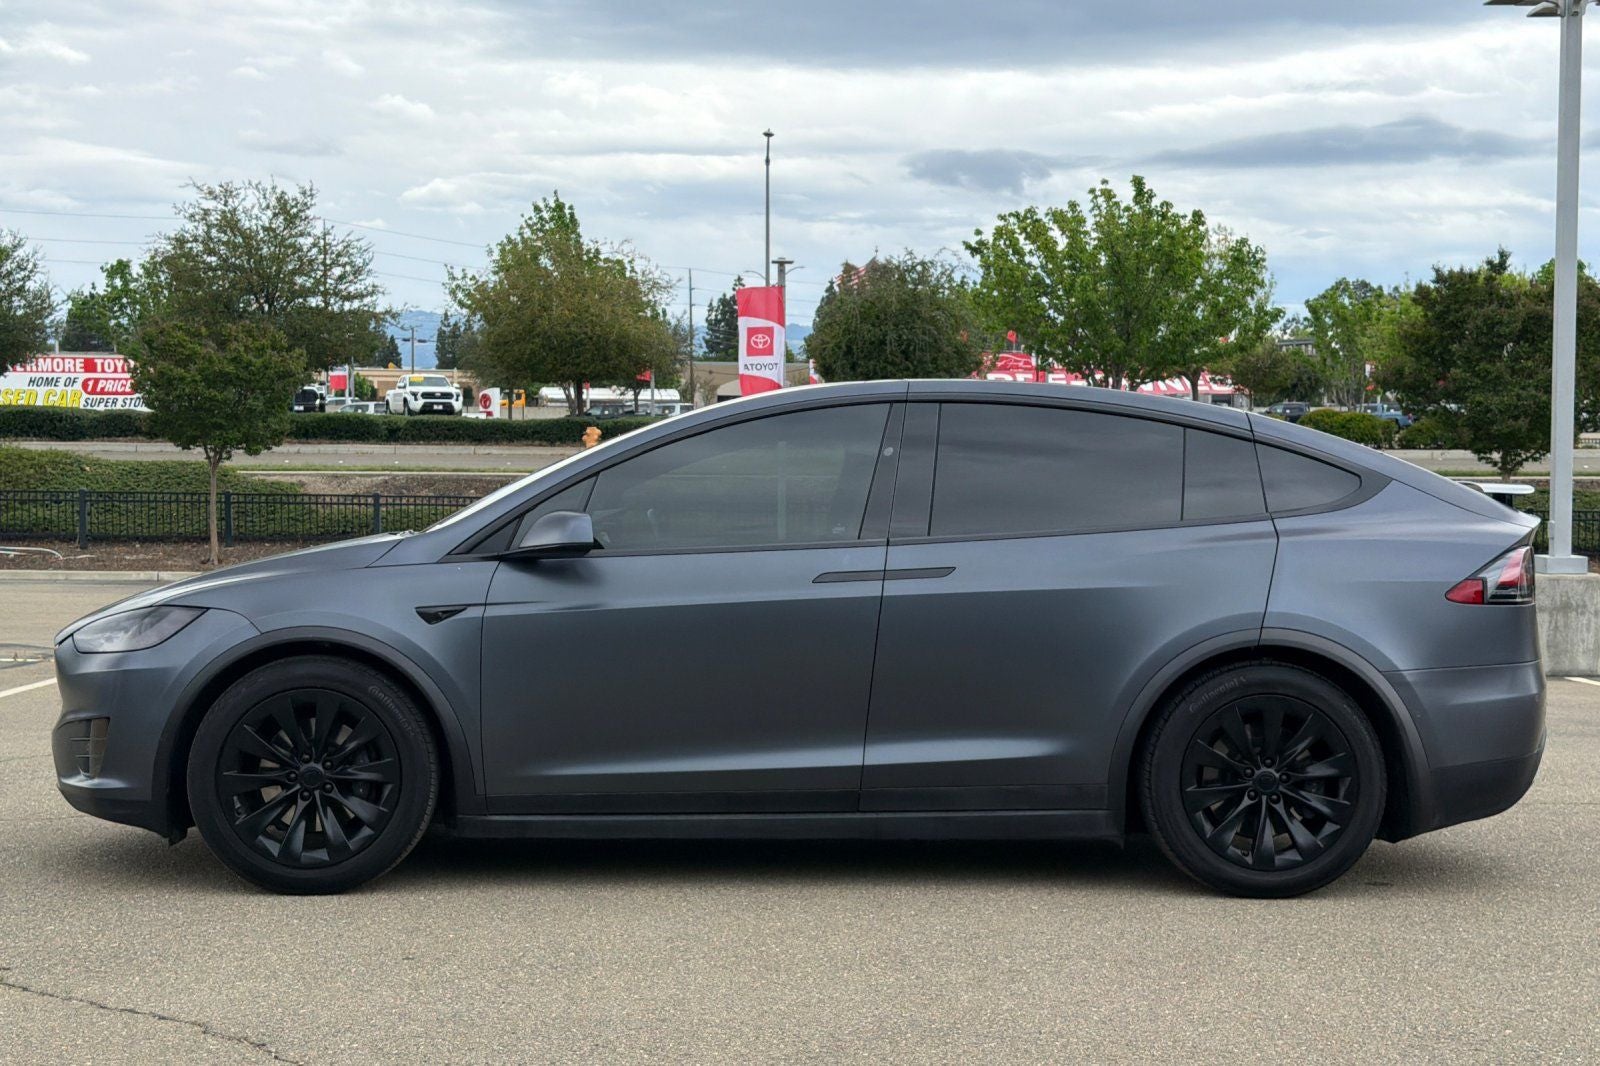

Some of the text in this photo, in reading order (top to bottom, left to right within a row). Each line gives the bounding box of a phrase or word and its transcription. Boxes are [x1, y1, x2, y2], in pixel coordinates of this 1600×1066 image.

[28, 377, 134, 393] HOME OF 1 PRICE
[0, 388, 38, 406] SED
[43, 388, 82, 408] CAR
[83, 397, 118, 408] SUPER
